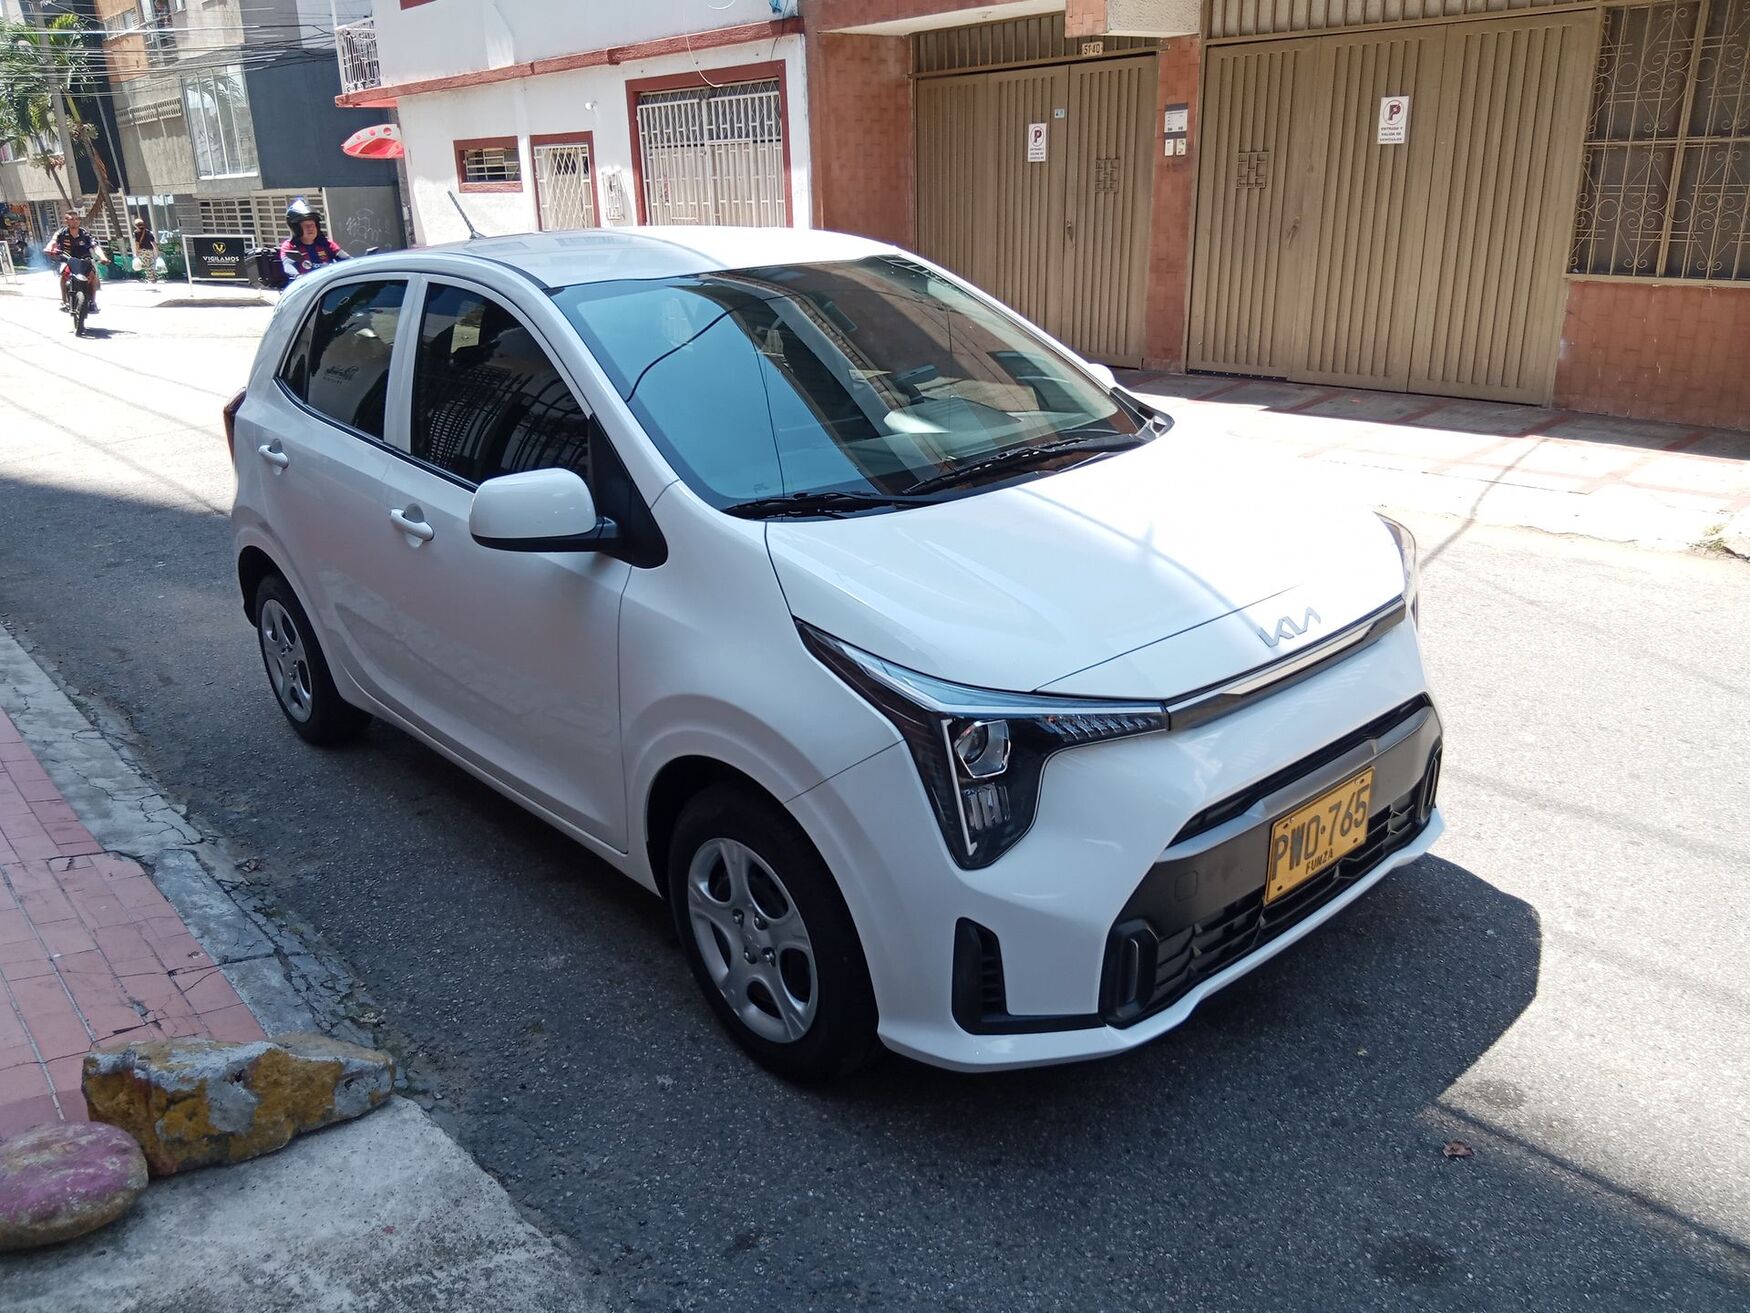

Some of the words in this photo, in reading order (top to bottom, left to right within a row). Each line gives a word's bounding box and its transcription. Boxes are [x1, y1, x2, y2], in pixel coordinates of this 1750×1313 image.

[1033, 129, 1043, 143] P
[1257, 607, 1322, 648] KIA
[1304, 847, 1334, 875] FUNZA
